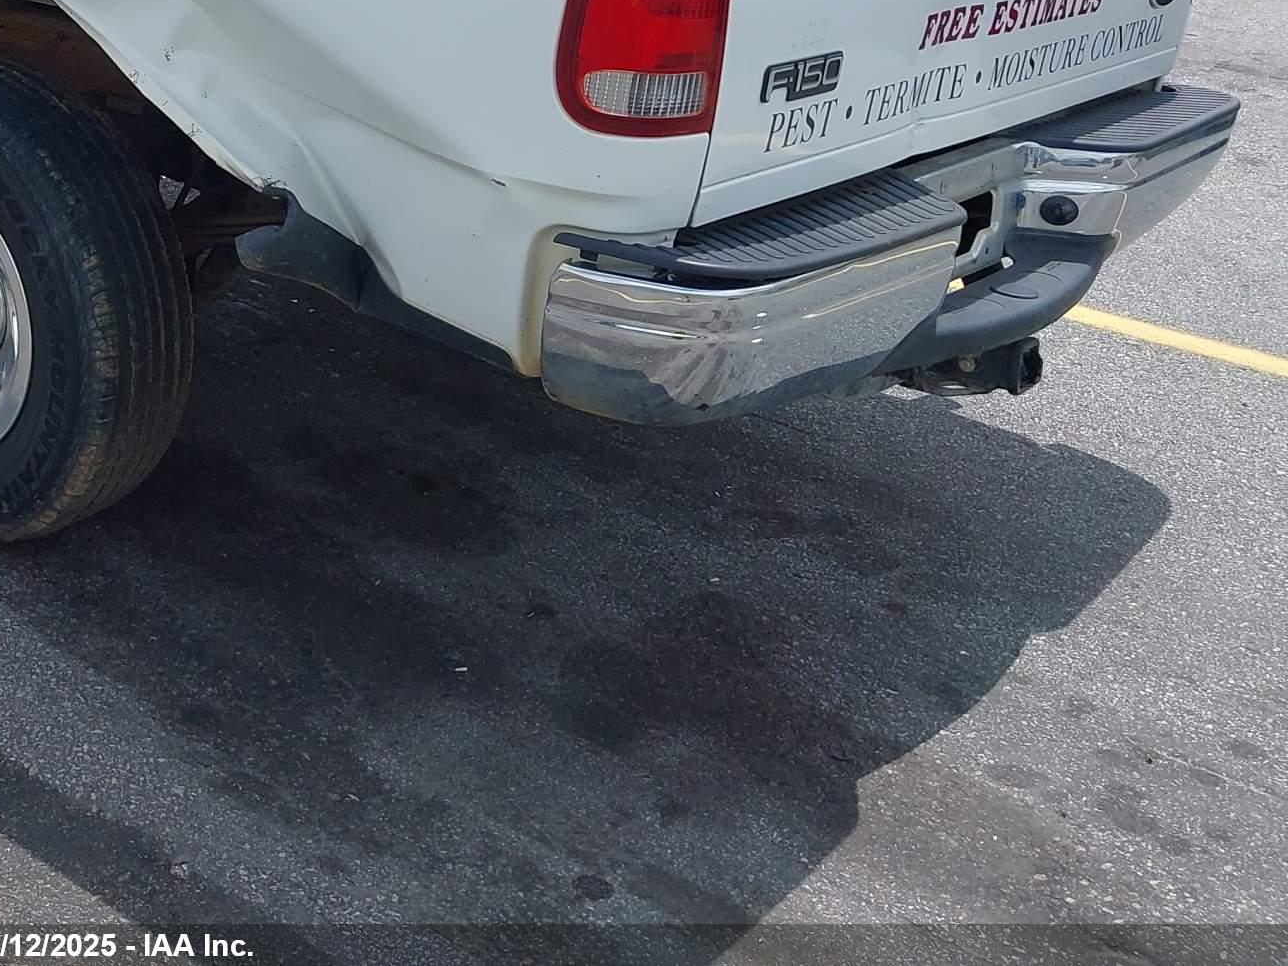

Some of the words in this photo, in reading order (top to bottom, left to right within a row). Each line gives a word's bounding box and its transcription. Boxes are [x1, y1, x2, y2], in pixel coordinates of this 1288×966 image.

[918, 3, 985, 51] FREE
[762, 98, 839, 154] PEST
[862, 63, 968, 126] TERMITE
[986, 34, 1090, 91] MOISTURE
[1090, 14, 1164, 62] CONTROL
